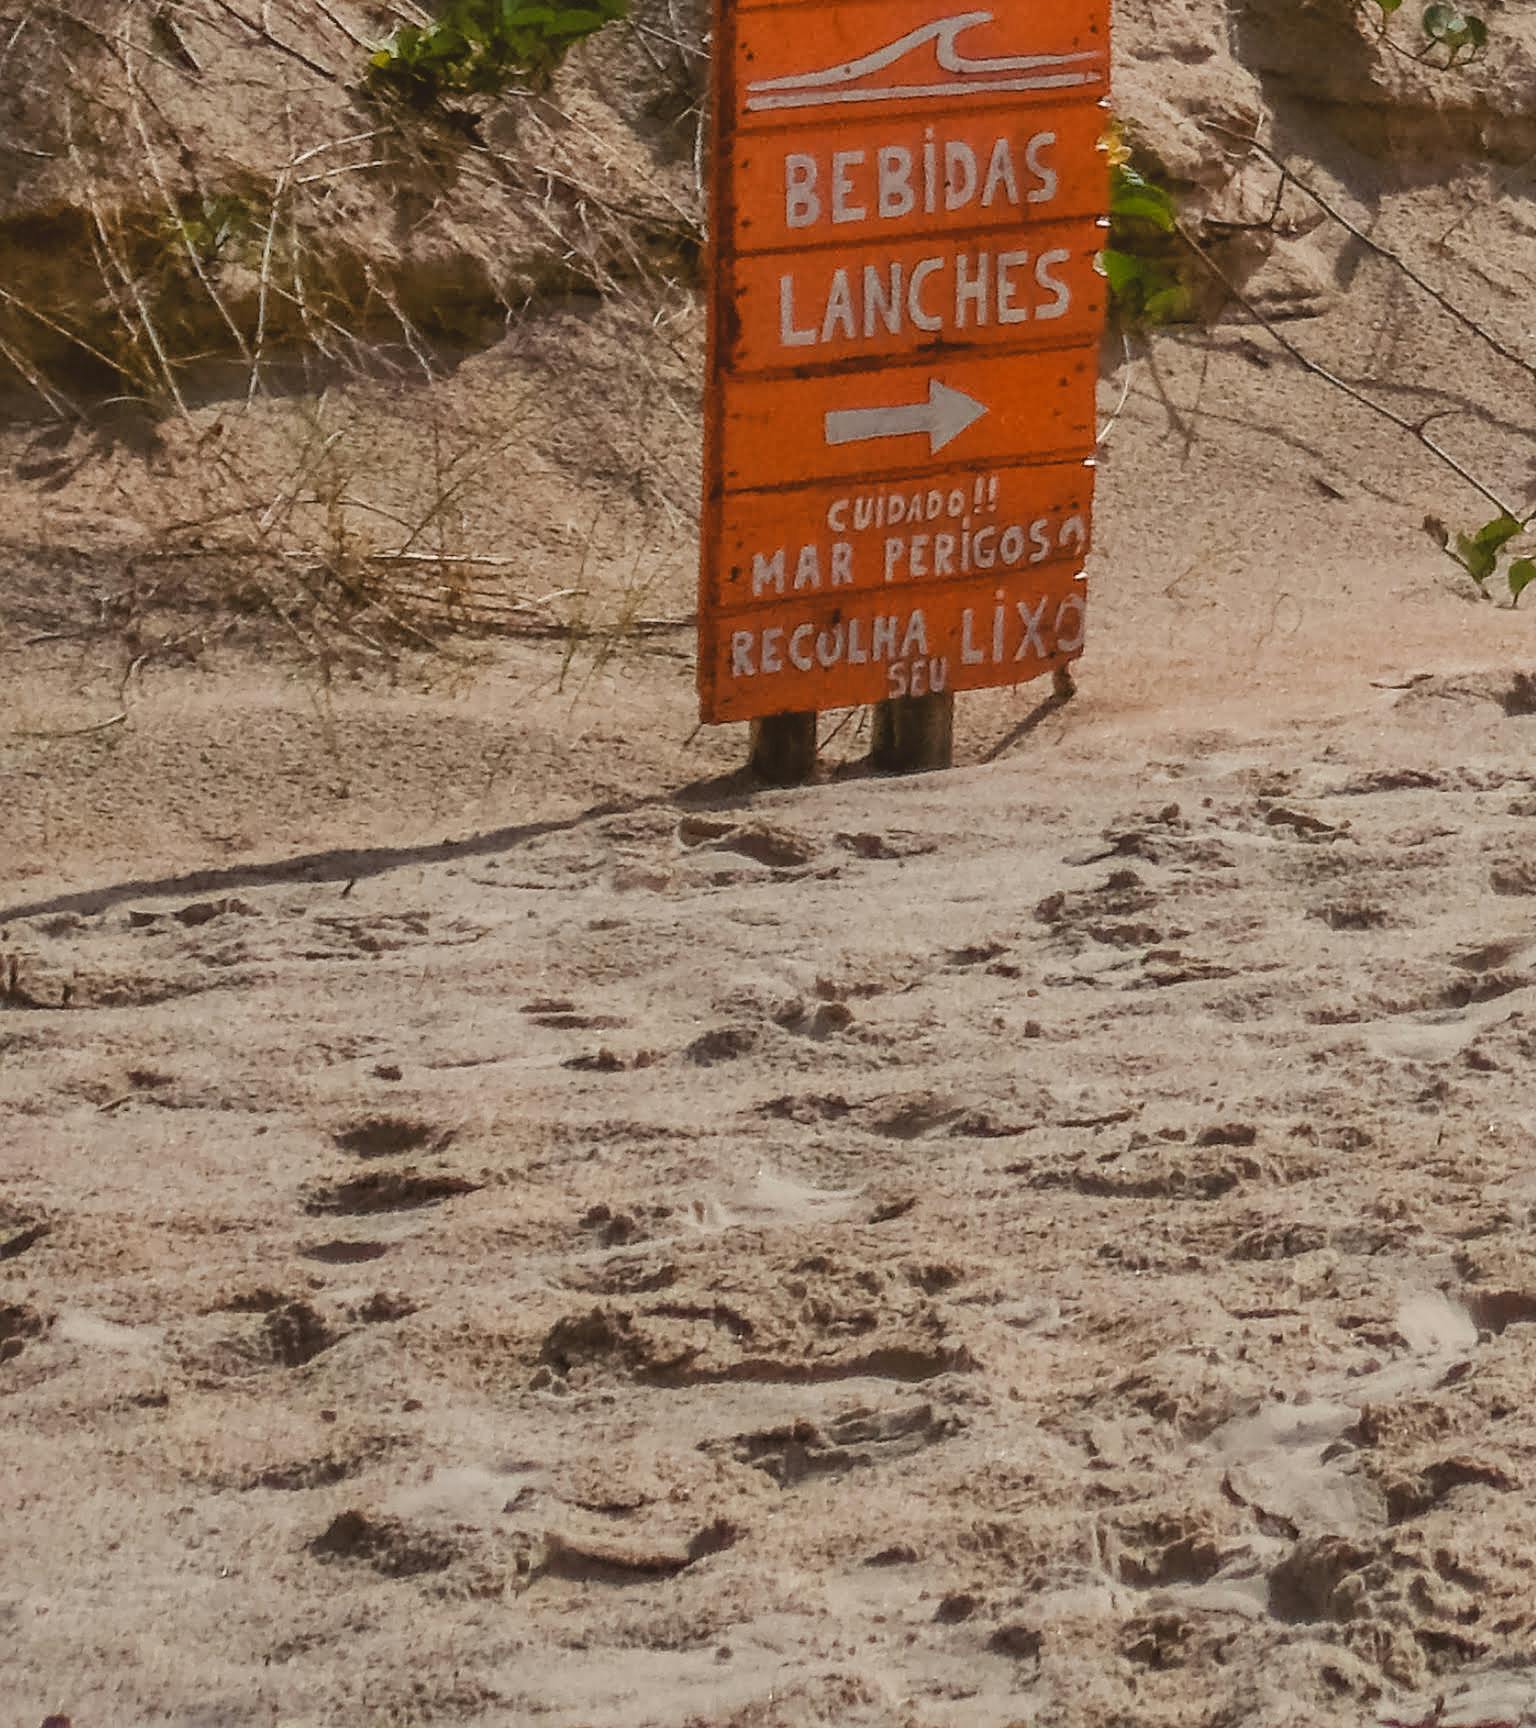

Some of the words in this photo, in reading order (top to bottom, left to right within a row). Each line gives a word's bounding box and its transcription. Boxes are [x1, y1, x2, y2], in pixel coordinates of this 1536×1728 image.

[784, 127, 1059, 229] BEBIDAS
[780, 248, 1072, 346] LANCHES
[751, 541, 855, 597] MAR
[731, 608, 928, 678] RECOLHA
[961, 589, 1087, 665] LIXO
[887, 656, 948, 700] SEU
